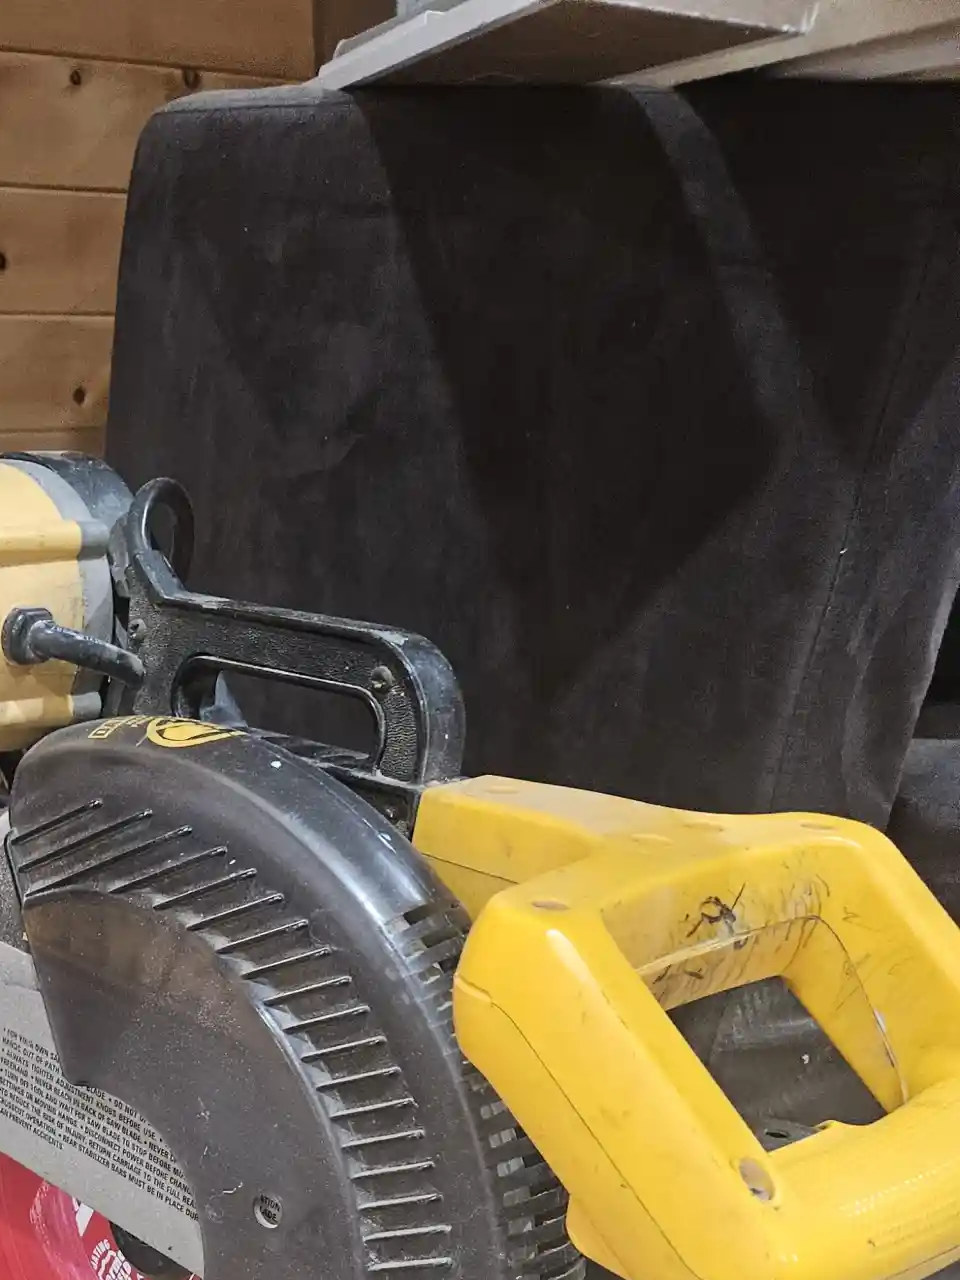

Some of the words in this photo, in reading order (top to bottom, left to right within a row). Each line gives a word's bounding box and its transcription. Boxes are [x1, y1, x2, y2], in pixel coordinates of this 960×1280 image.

[6, 1049, 28, 1066] ALWAYS
[31, 1064, 53, 1081] TIGHTEN
[55, 1077, 93, 1104] ADJUSTMENT
[95, 1101, 116, 1117] KNOBS
[118, 1114, 140, 1131] BEFORE
[22, 1048, 33, 1059] OUT
[44, 1060, 59, 1073] PATH
[124, 1106, 137, 1117] NOT
[35, 1044, 48, 1055] OWN
[49, 1052, 59, 1061] SA
[0, 1077, 25, 1096] SETTINGS
[34, 1097, 56, 1115] MOVING
[85, 1127, 121, 1152] DISCONNECT
[122, 1149, 144, 1166] POWER
[145, 1162, 169, 1180] BEFORE
[5, 1070, 18, 1082] TURN
[30, 1085, 44, 1097] TOOL
[45, 1093, 57, 1105] AND
[59, 1101, 73, 1114] WAIT
[74, 1110, 86, 1121] FOR
[87, 1117, 101, 1130] SAW
[101, 1125, 121, 1142] BLADE
[131, 1143, 147, 1157] STOP
[148, 1152, 171, 1171] BEFORE
[8, 1112, 32, 1131] PREVENT
[9, 1093, 29, 1109] REDUCE
[31, 1106, 41, 1116] THE
[42, 1112, 55, 1124] RISK
[88, 1139, 111, 1157] RETURN
[111, 1153, 141, 1175] CARRIAGE
[153, 1177, 165, 1189] THE
[166, 1185, 180, 1198] FULL
[34, 1076, 52, 1091] NEVER
[53, 1087, 71, 1102] REACH
[80, 1103, 96, 1116] BACK
[106, 1117, 120, 1130] SAW
[148, 1141, 169, 1158] NEVER
[62, 1134, 77, 1148] REAR
[78, 1144, 110, 1168] STABILIZER
[111, 1164, 127, 1178] BARS
[128, 1174, 145, 1189] MUST
[164, 1195, 184, 1212] PLACE
[185, 1208, 199, 1221] DUR
